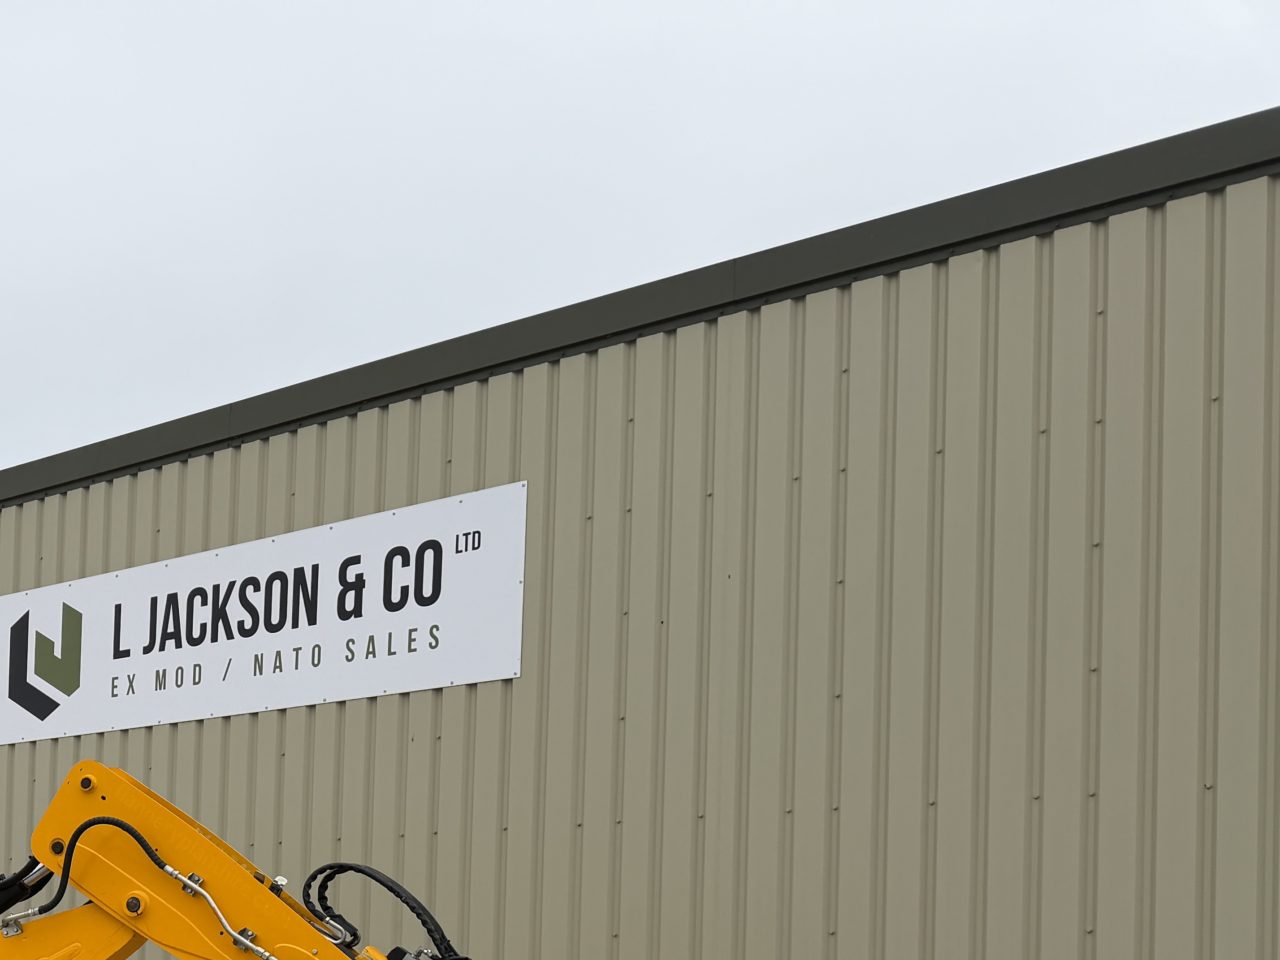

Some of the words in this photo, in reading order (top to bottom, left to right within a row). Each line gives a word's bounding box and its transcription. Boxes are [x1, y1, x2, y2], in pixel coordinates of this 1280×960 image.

[113, 603, 130, 659] L
[142, 563, 320, 655] JACKSON
[337, 554, 367, 621] &
[383, 539, 444, 612] CO
[455, 531, 481, 554] LTD
[111, 673, 136, 698] EX
[155, 664, 201, 691] MOD
[254, 644, 321, 676] NATO
[344, 623, 440, 662] SALES
